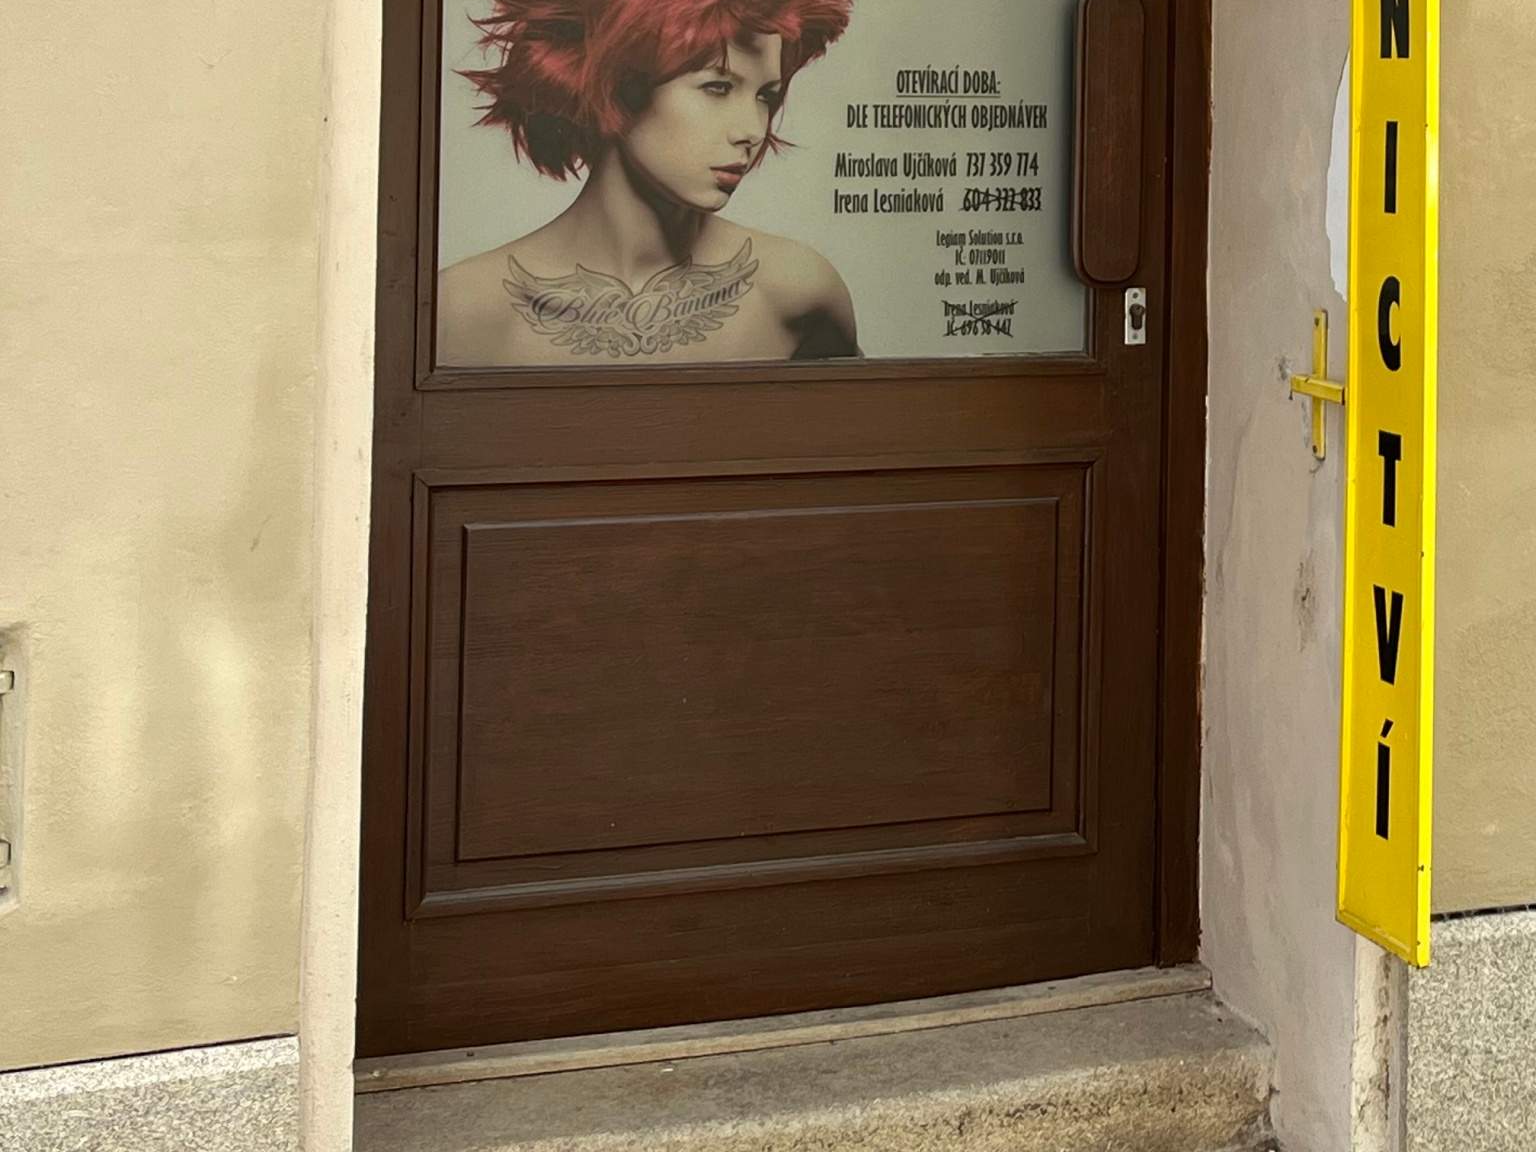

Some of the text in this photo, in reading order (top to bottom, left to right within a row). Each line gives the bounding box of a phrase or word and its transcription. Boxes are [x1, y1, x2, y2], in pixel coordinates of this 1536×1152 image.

[896, 64, 1001, 95] OTEVÍRACÍ DOBA:
[846, 98, 1048, 132] DLE TELEFONICKÝCH OBJEDNÁVEK
[834, 152, 1039, 180] Miroslava Ujčíková 737 359 774
[834, 189, 869, 214] Irena
[873, 187, 944, 213] Lesniaková
[969, 229, 1003, 246] Solution
[531, 279, 743, 330] Blue Banana
